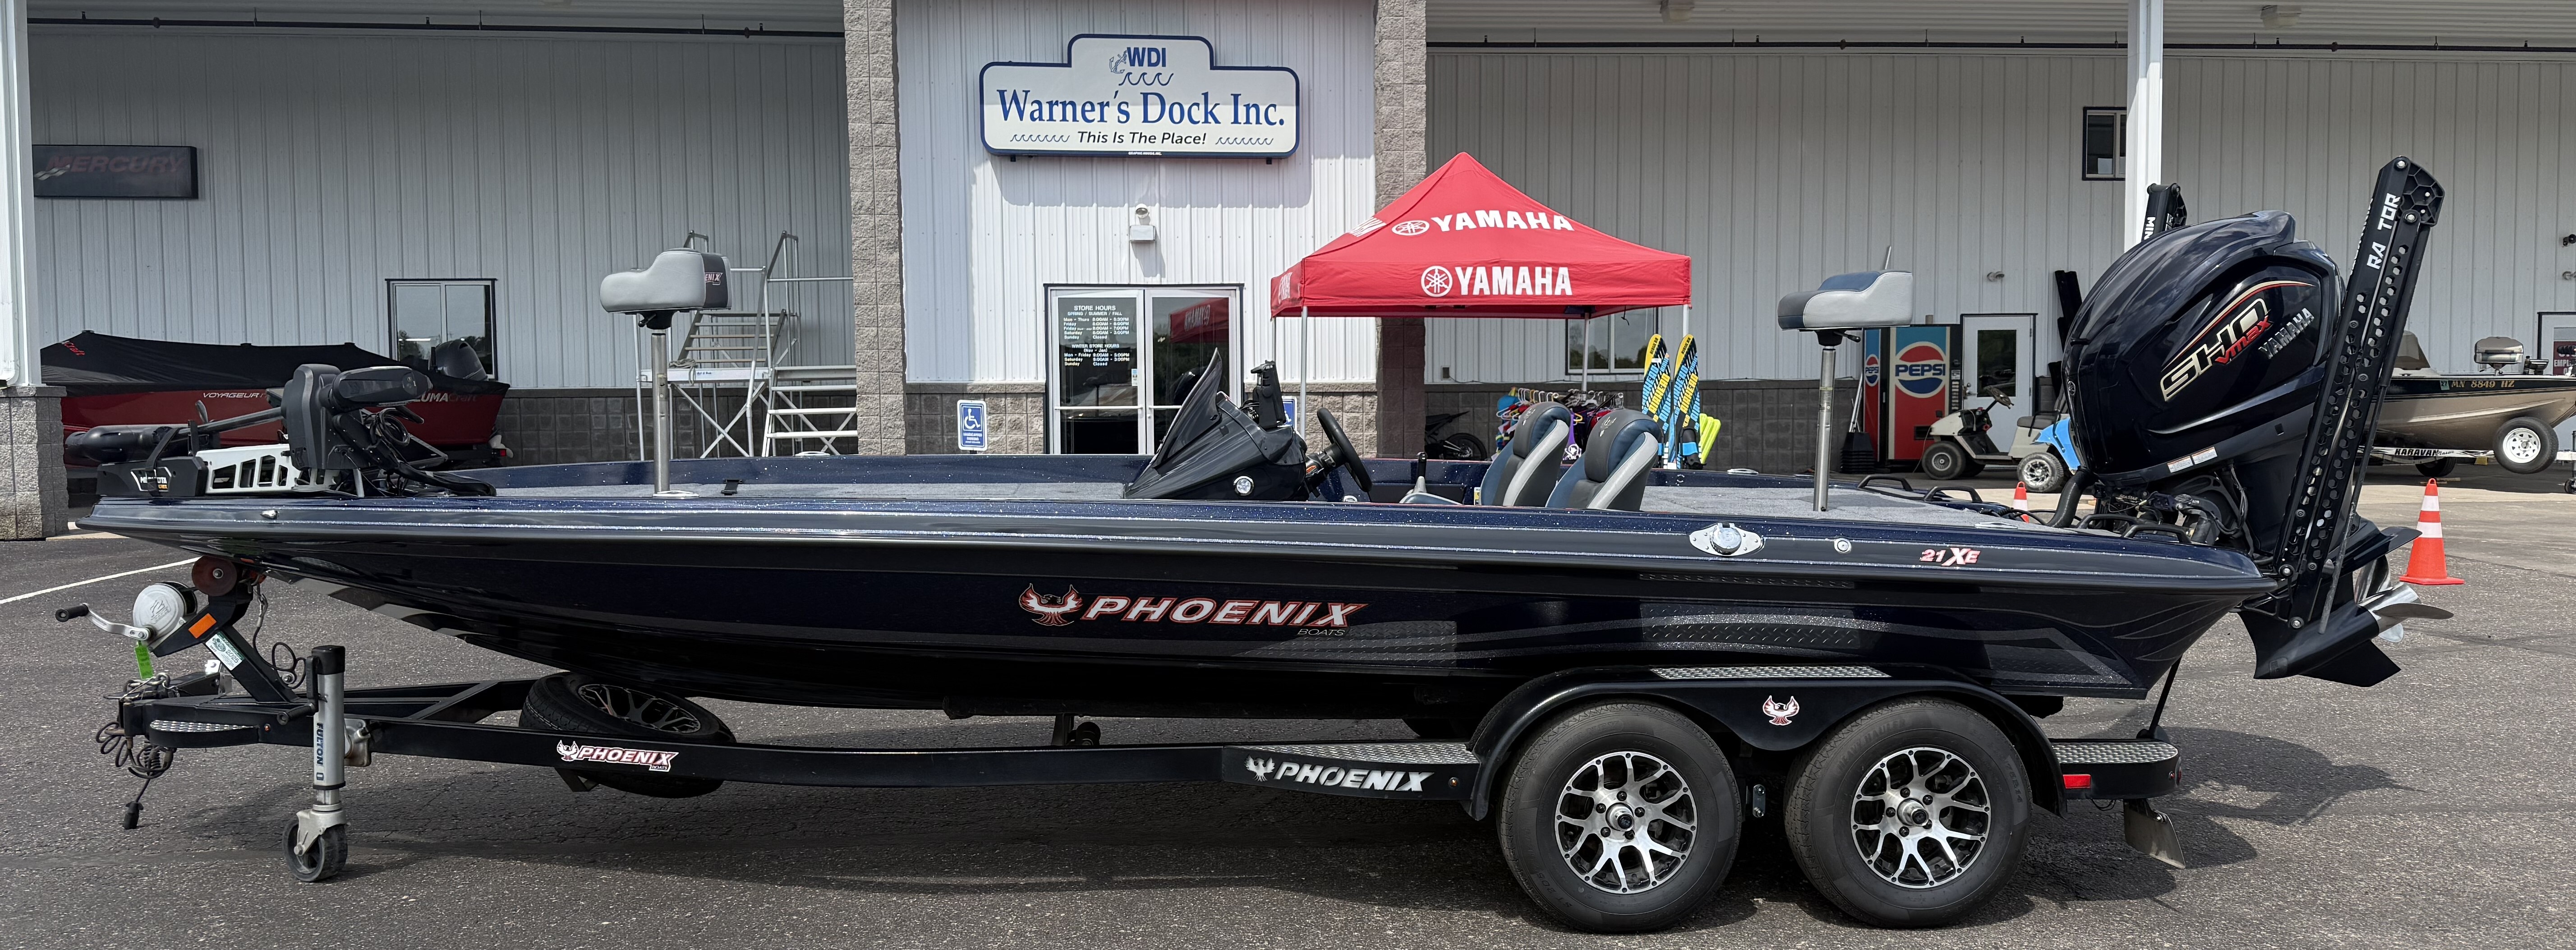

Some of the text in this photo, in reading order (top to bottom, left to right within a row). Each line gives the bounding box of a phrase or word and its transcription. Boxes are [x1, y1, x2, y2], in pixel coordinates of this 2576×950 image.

[1127, 46, 1166, 68] WDI
[996, 89, 1285, 126] Warner's Dock Inc.
[1078, 131, 1207, 145] This Is The Place!
[46, 155, 184, 173] MERCURY
[1431, 210, 1575, 232] YAMAHA
[705, 273, 720, 281] ENIX
[1455, 266, 1573, 296] YAMAHA
[2258, 308, 2315, 360] YAMAHA
[2160, 298, 2268, 401] SHO
[1895, 364, 1946, 377] PEPSI
[1079, 595, 1369, 629] PHOENIX
[1297, 628, 1345, 636] BOATS
[226, 650, 239, 663] 2025
[576, 746, 678, 766] PHOENIX
[1273, 761, 1435, 792] PHOENIX
